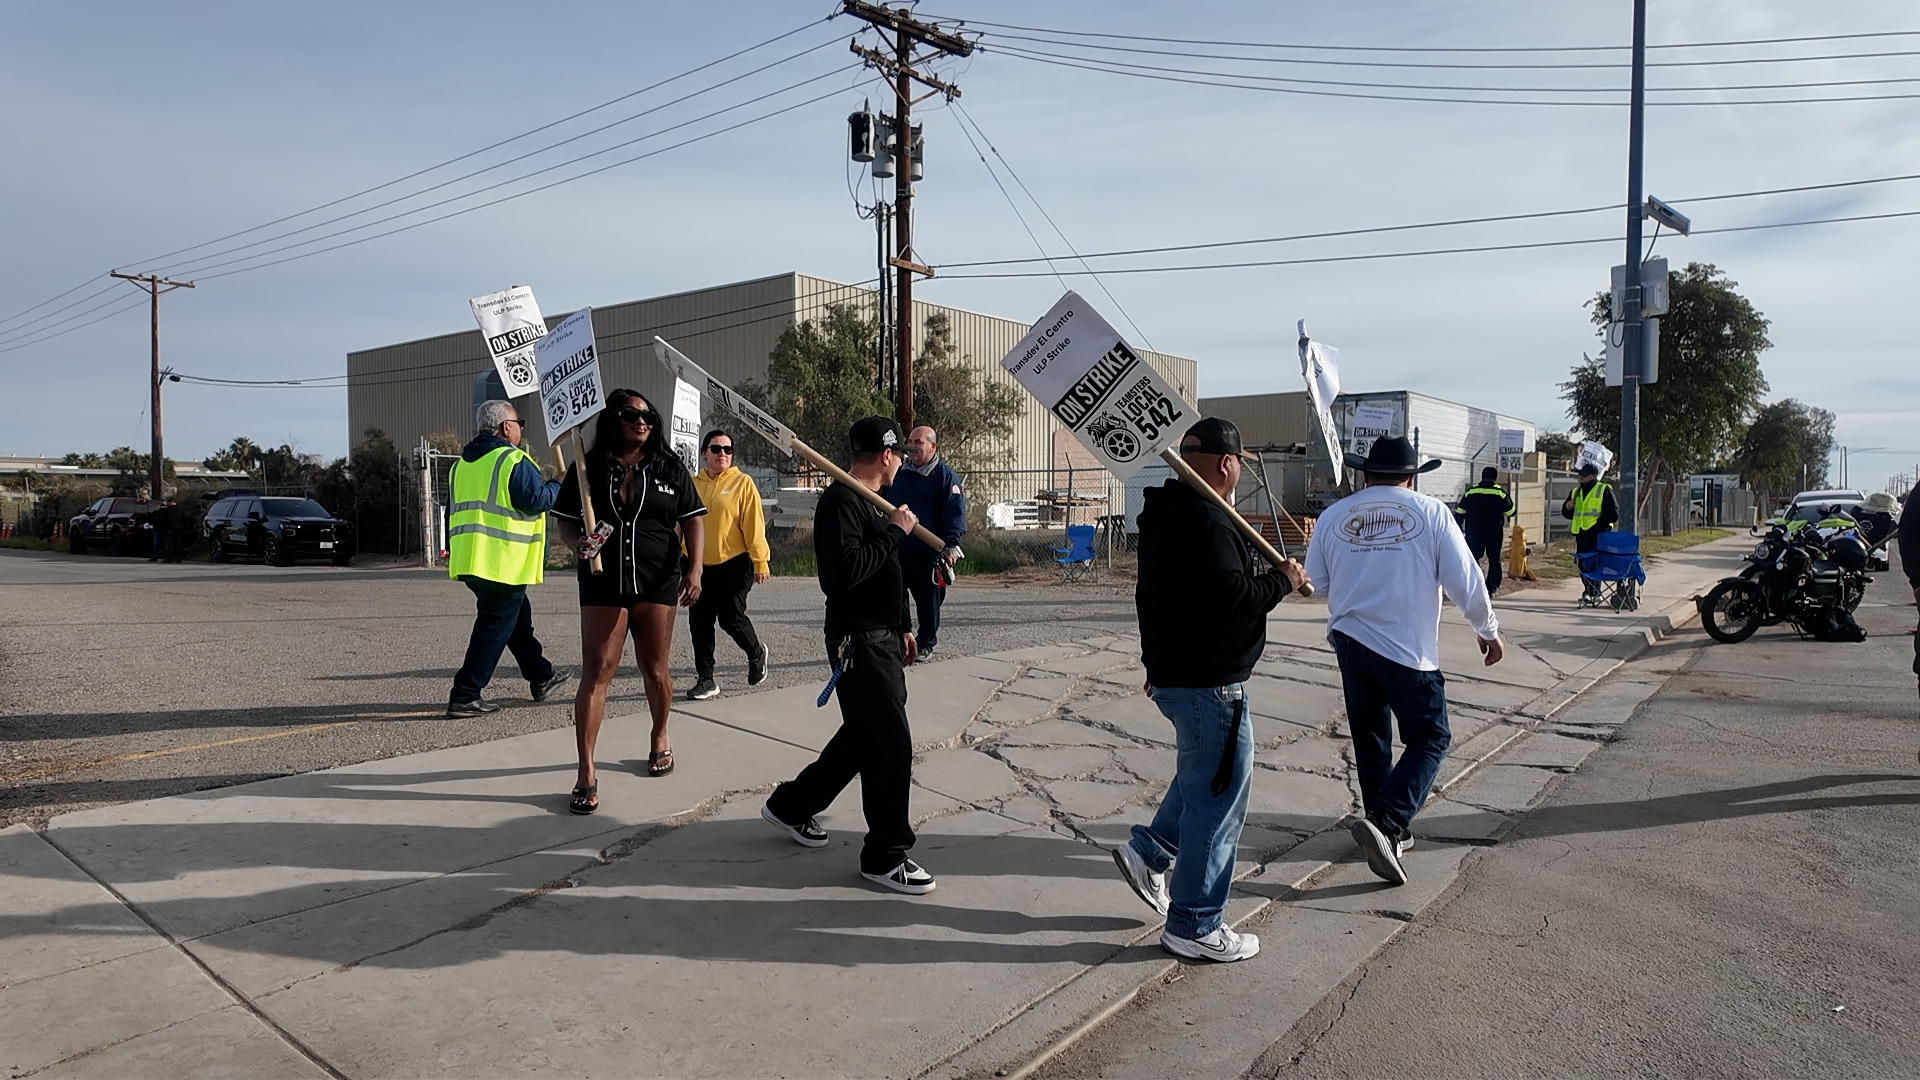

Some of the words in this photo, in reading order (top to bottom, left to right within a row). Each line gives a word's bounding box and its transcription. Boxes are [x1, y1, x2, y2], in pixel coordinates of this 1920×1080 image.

[477, 297, 504, 310] Transdev
[511, 293, 530, 301] Centro
[493, 308, 505, 316] ULP
[563, 314, 585, 329] Centro
[492, 335, 510, 353] ON
[555, 330, 573, 344] Strike
[1008, 343, 1041, 376] Transdev
[1037, 335, 1049, 347] El
[1045, 309, 1075, 338] Centro
[1032, 358, 1049, 375] ULP
[1047, 337, 1071, 361] Strike
[542, 374, 556, 396] ON
[554, 346, 593, 382] STRIKE
[568, 371, 594, 389] TEAMSTERS
[569, 378, 595, 400] LOCAL
[1058, 394, 1086, 424] ON
[1074, 344, 1131, 405] STRIKE
[1114, 376, 1152, 410] TEAMSTERS
[572, 388, 598, 416] 542
[1121, 385, 1164, 423] LOCAL
[1134, 397, 1183, 441] 542
[1355, 427, 1365, 436] ON
